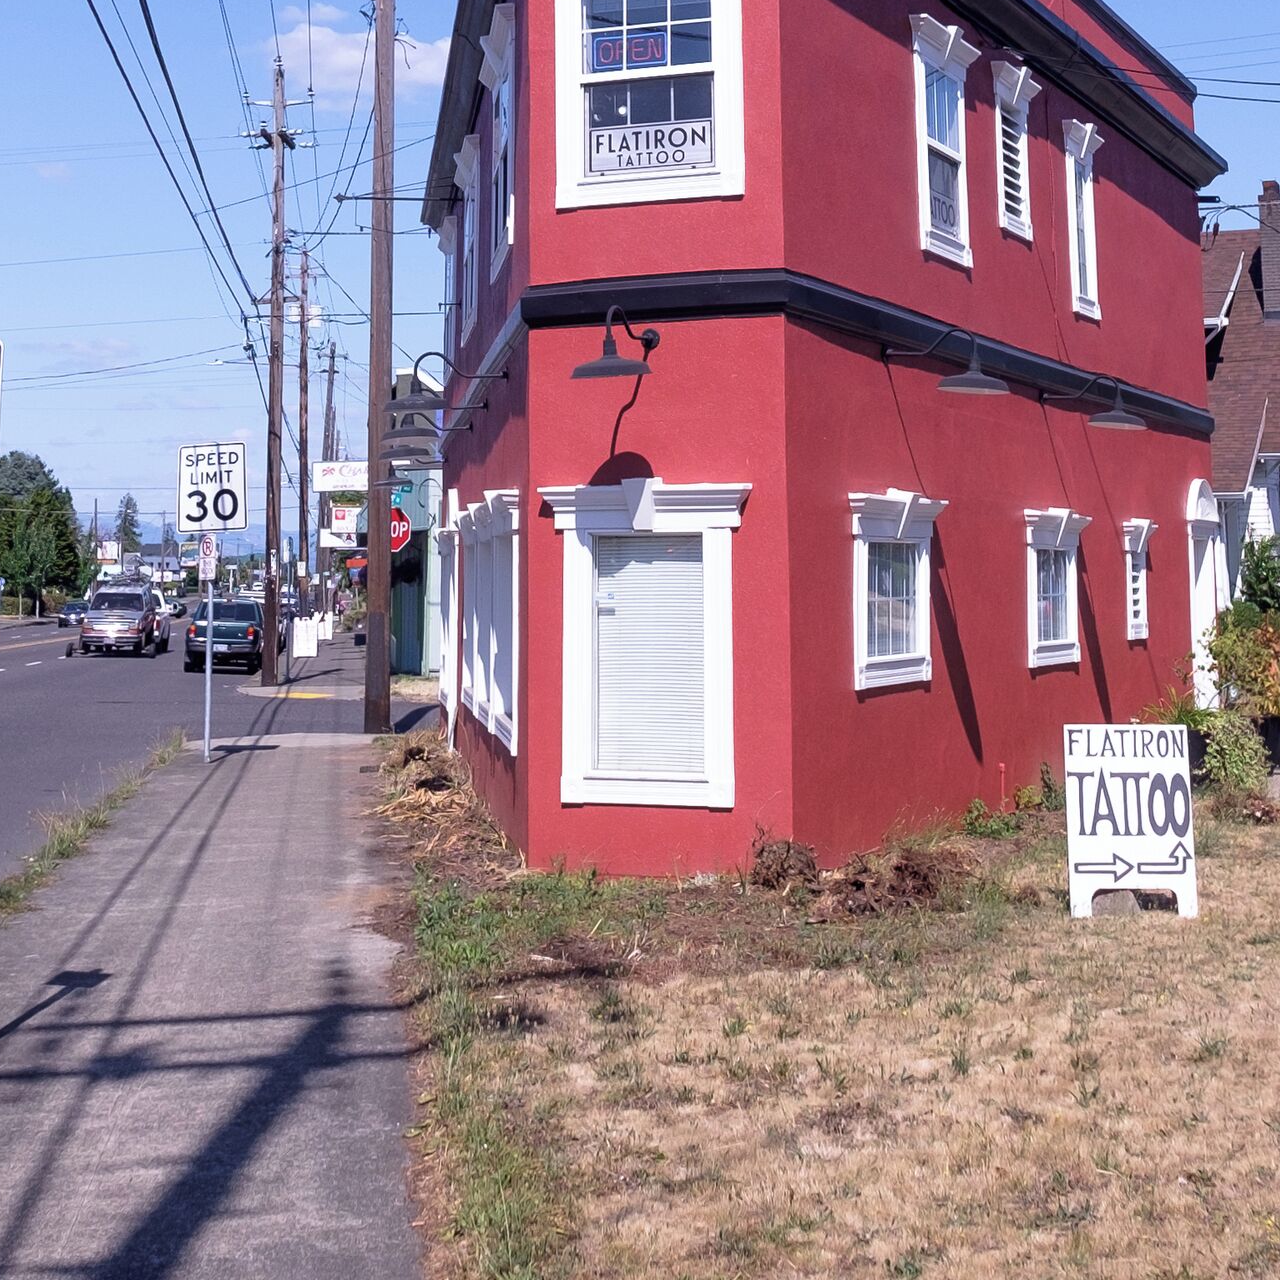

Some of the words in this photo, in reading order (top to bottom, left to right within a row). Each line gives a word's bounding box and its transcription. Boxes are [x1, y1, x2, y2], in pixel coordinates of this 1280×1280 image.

[600, 38, 662, 63] OPEN
[596, 126, 706, 154] FLATIRON
[617, 149, 685, 167] TATTOO
[185, 452, 239, 467] SPEED
[190, 470, 233, 485] LIMIT
[185, 488, 239, 523] 30
[1067, 728, 1185, 758] FLATIRON
[1066, 765, 1190, 838] TATTOO
